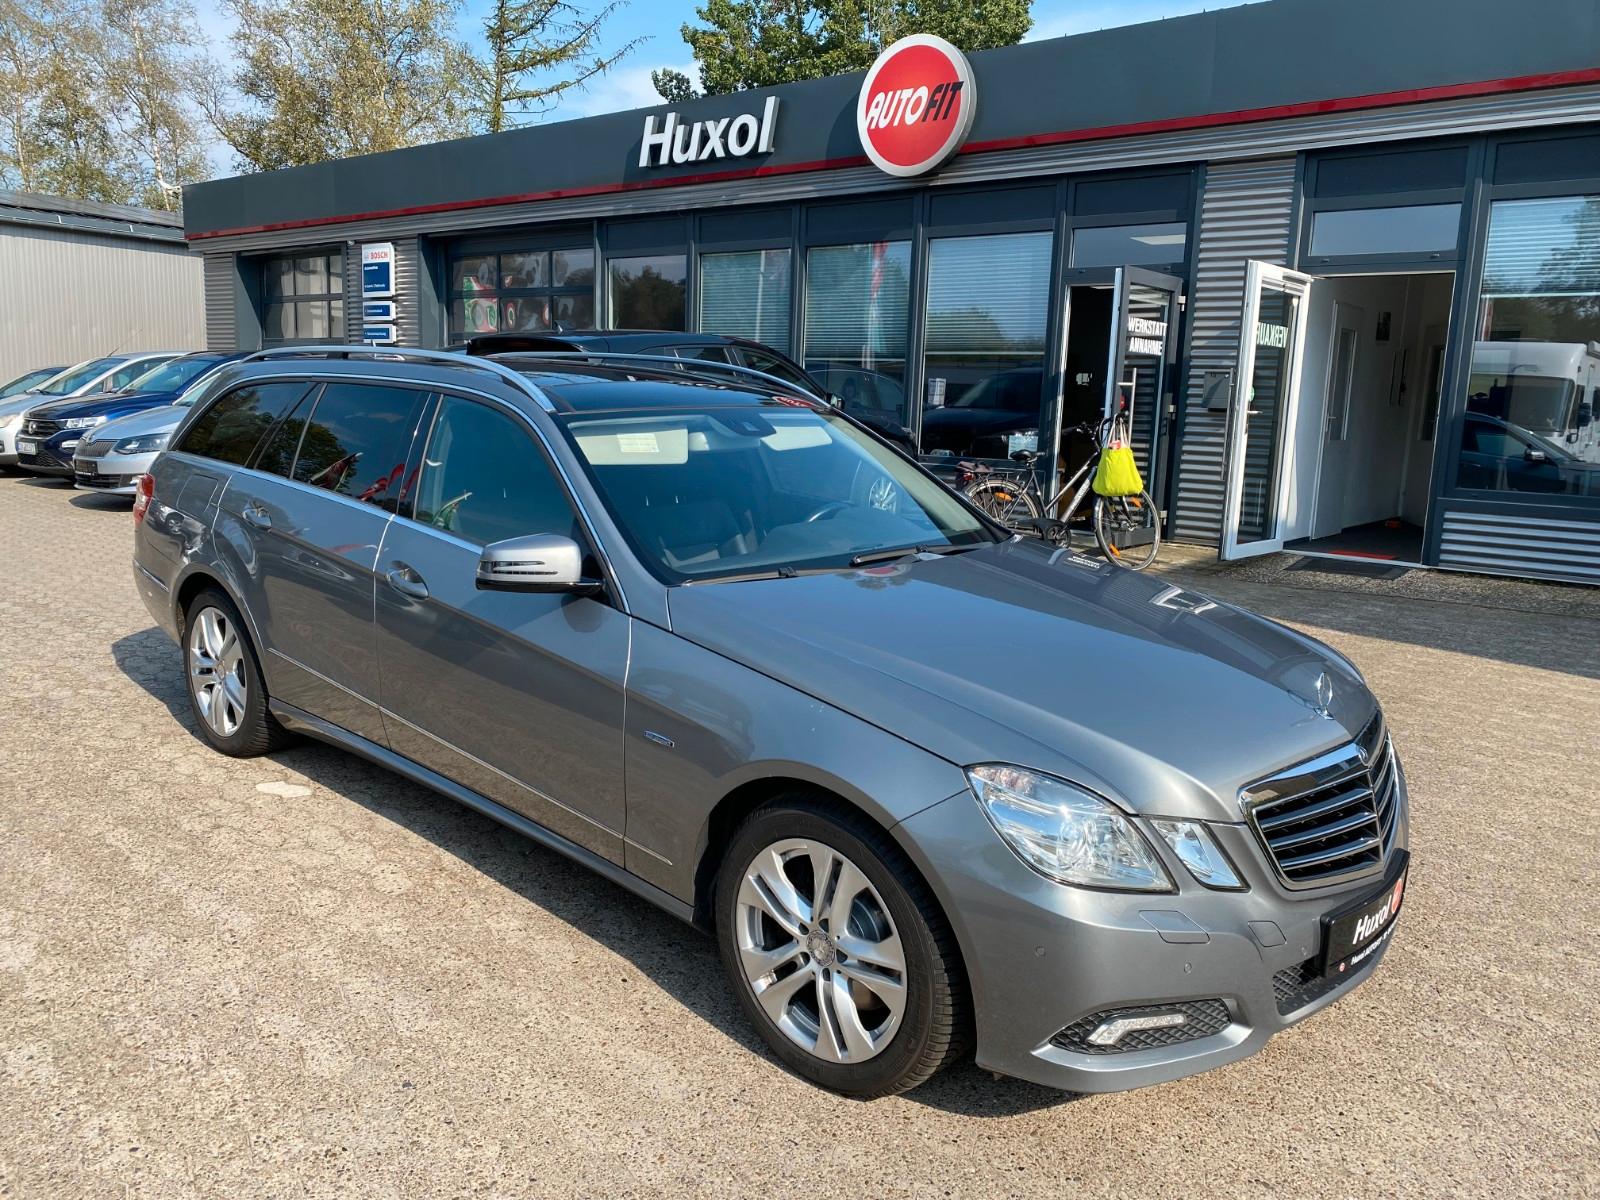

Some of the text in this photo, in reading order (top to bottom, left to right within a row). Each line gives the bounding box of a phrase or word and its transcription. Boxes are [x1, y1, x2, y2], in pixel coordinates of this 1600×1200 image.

[866, 81, 964, 129] AUTOFIT
[638, 96, 780, 168] Huxol
[370, 251, 389, 260] BOSCH
[1128, 316, 1168, 337] WERKSTATT
[1129, 337, 1163, 356] ANNAHME
[1352, 894, 1392, 945] Huxol
